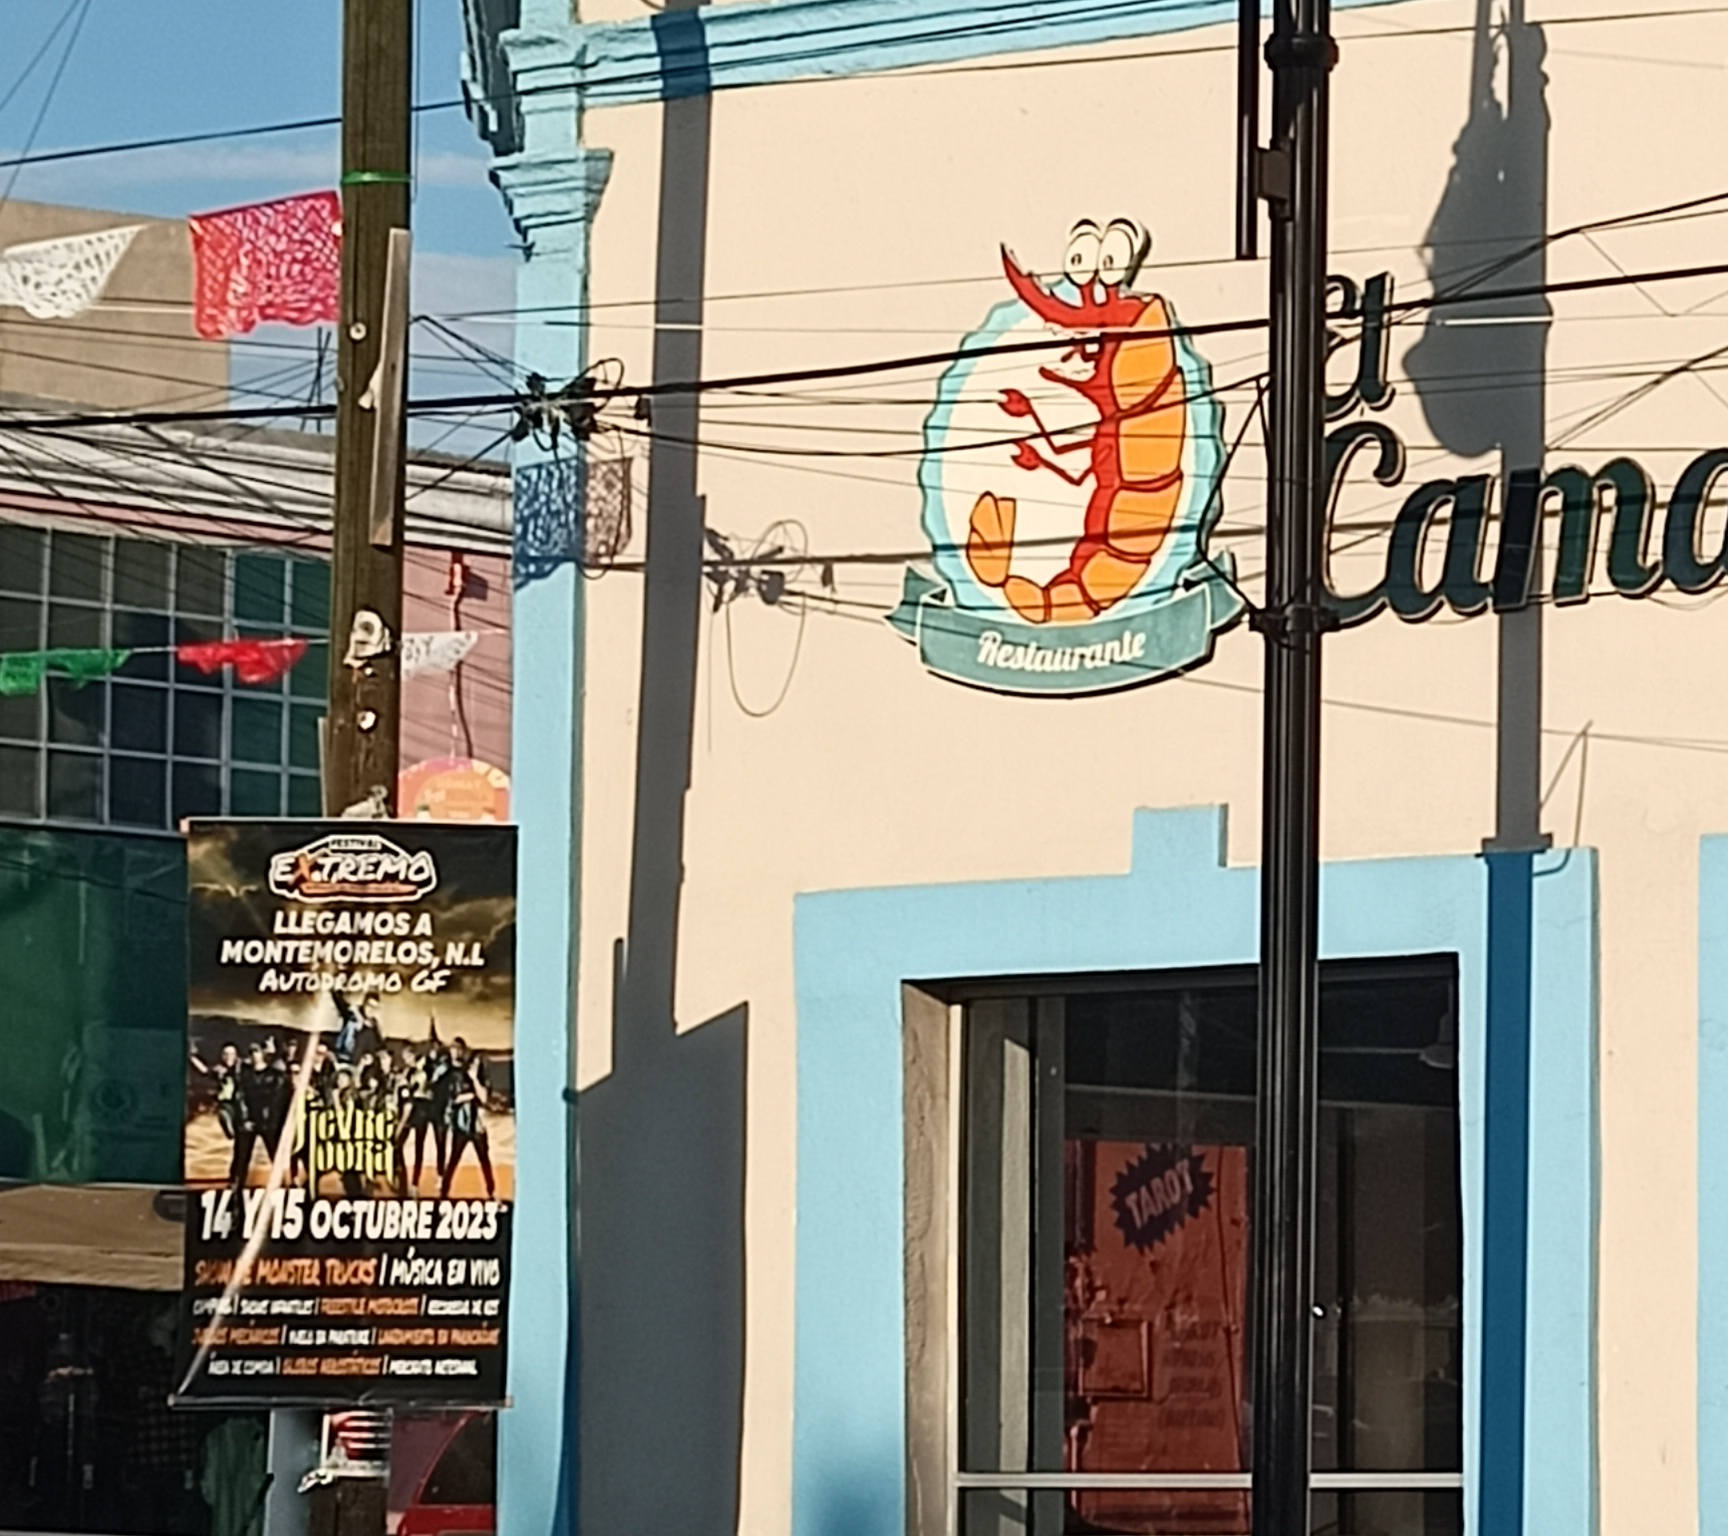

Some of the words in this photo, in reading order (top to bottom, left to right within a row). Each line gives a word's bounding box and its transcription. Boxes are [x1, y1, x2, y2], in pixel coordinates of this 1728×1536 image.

[977, 629, 1146, 672] Restaurante
[330, 838, 380, 850] FESTIVAL
[273, 910, 411, 936] LLEGAMOS
[413, 912, 433, 936] A
[220, 939, 440, 969] MONTEMORELOS,
[200, 1189, 233, 1240] 14
[242, 1189, 269, 1239] Y
[269, 1188, 306, 1239] 15
[310, 1199, 433, 1240] OCTUBRE
[435, 1200, 498, 1240] 2023
[1124, 1158, 1196, 1230] TAROT
[256, 1258, 321, 1286] MONSTER
[325, 1258, 377, 1286] TRUCKS
[389, 1246, 443, 1286] MÚSICA
[447, 1258, 467, 1286] EN
[470, 1258, 500, 1286] VIVO
